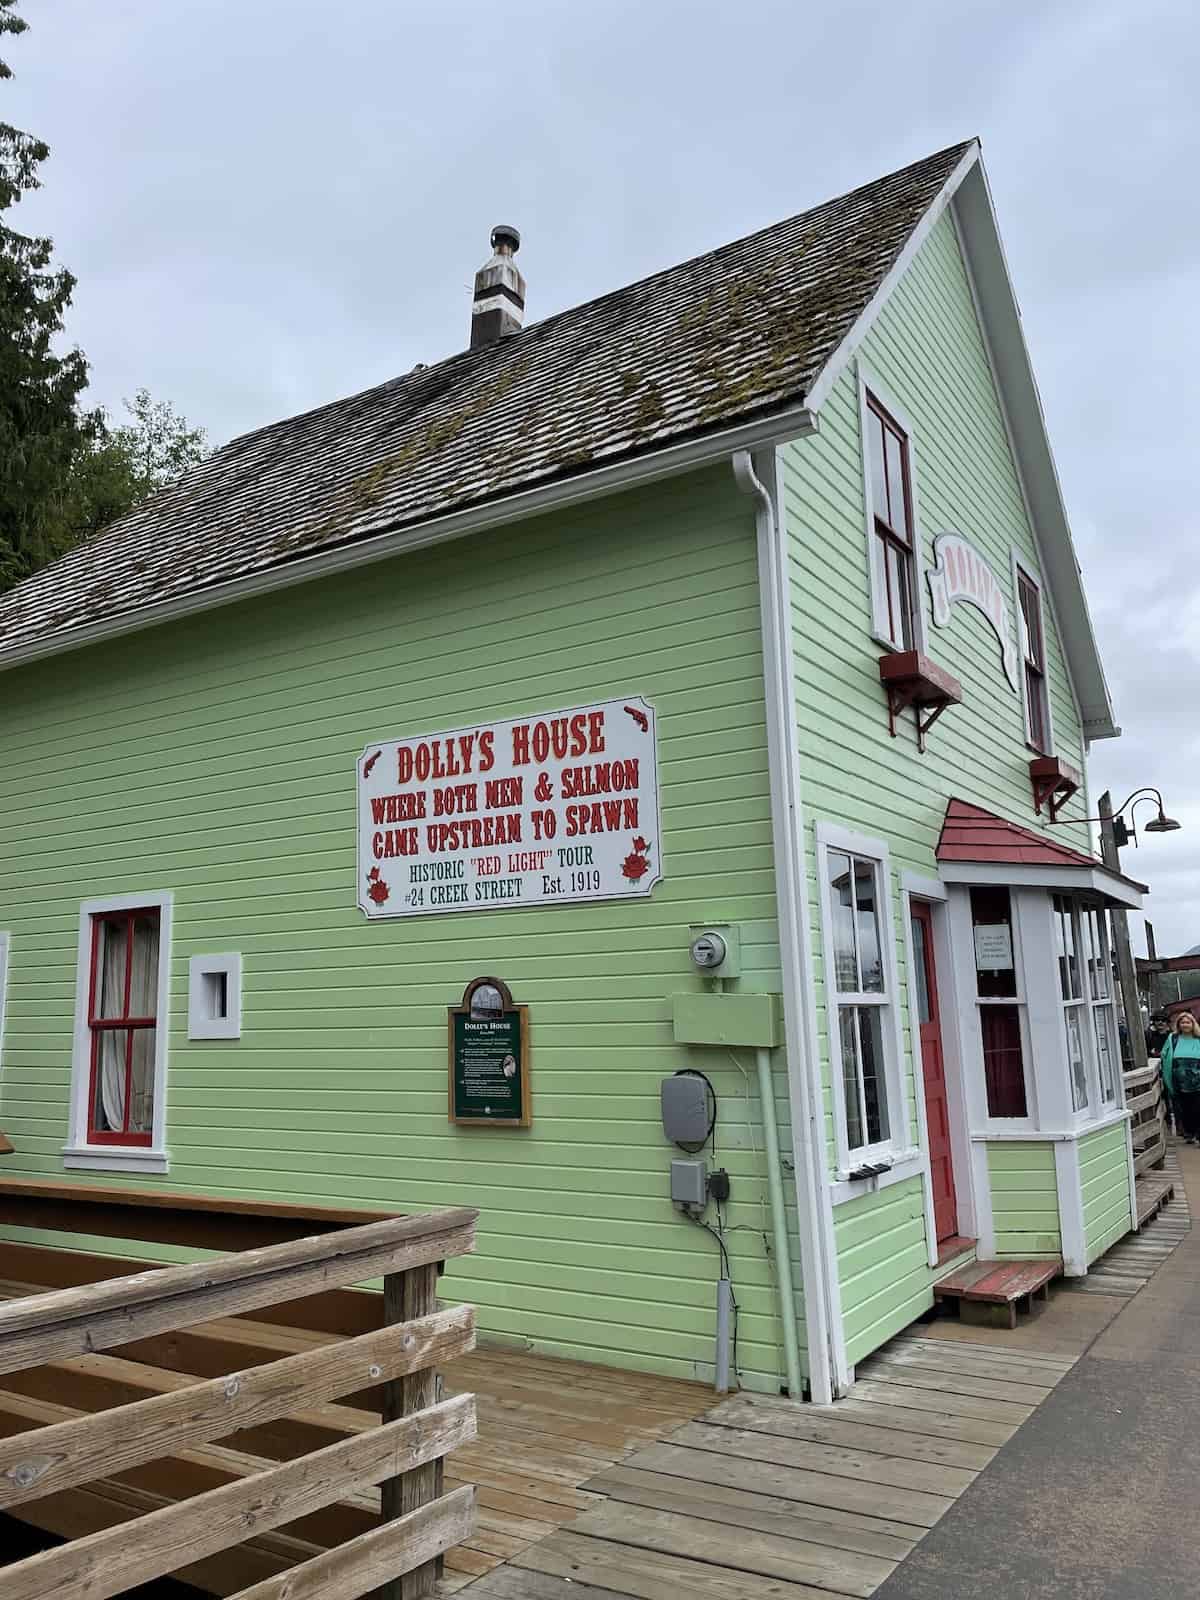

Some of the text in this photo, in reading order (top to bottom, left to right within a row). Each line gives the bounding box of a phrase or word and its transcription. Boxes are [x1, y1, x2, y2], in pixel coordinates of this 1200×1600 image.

[398, 711, 605, 784] DOLLY'S HOUSE
[371, 758, 639, 825] WHERE BOTH MEN & SALMON
[372, 798, 639, 859] CAME UPSTREAM TO SPAWN
[405, 870, 600, 907] #24 CREEK STREET Est. 1919
[409, 846, 593, 883] HISTORIC "RED LIGHT" TOUR
